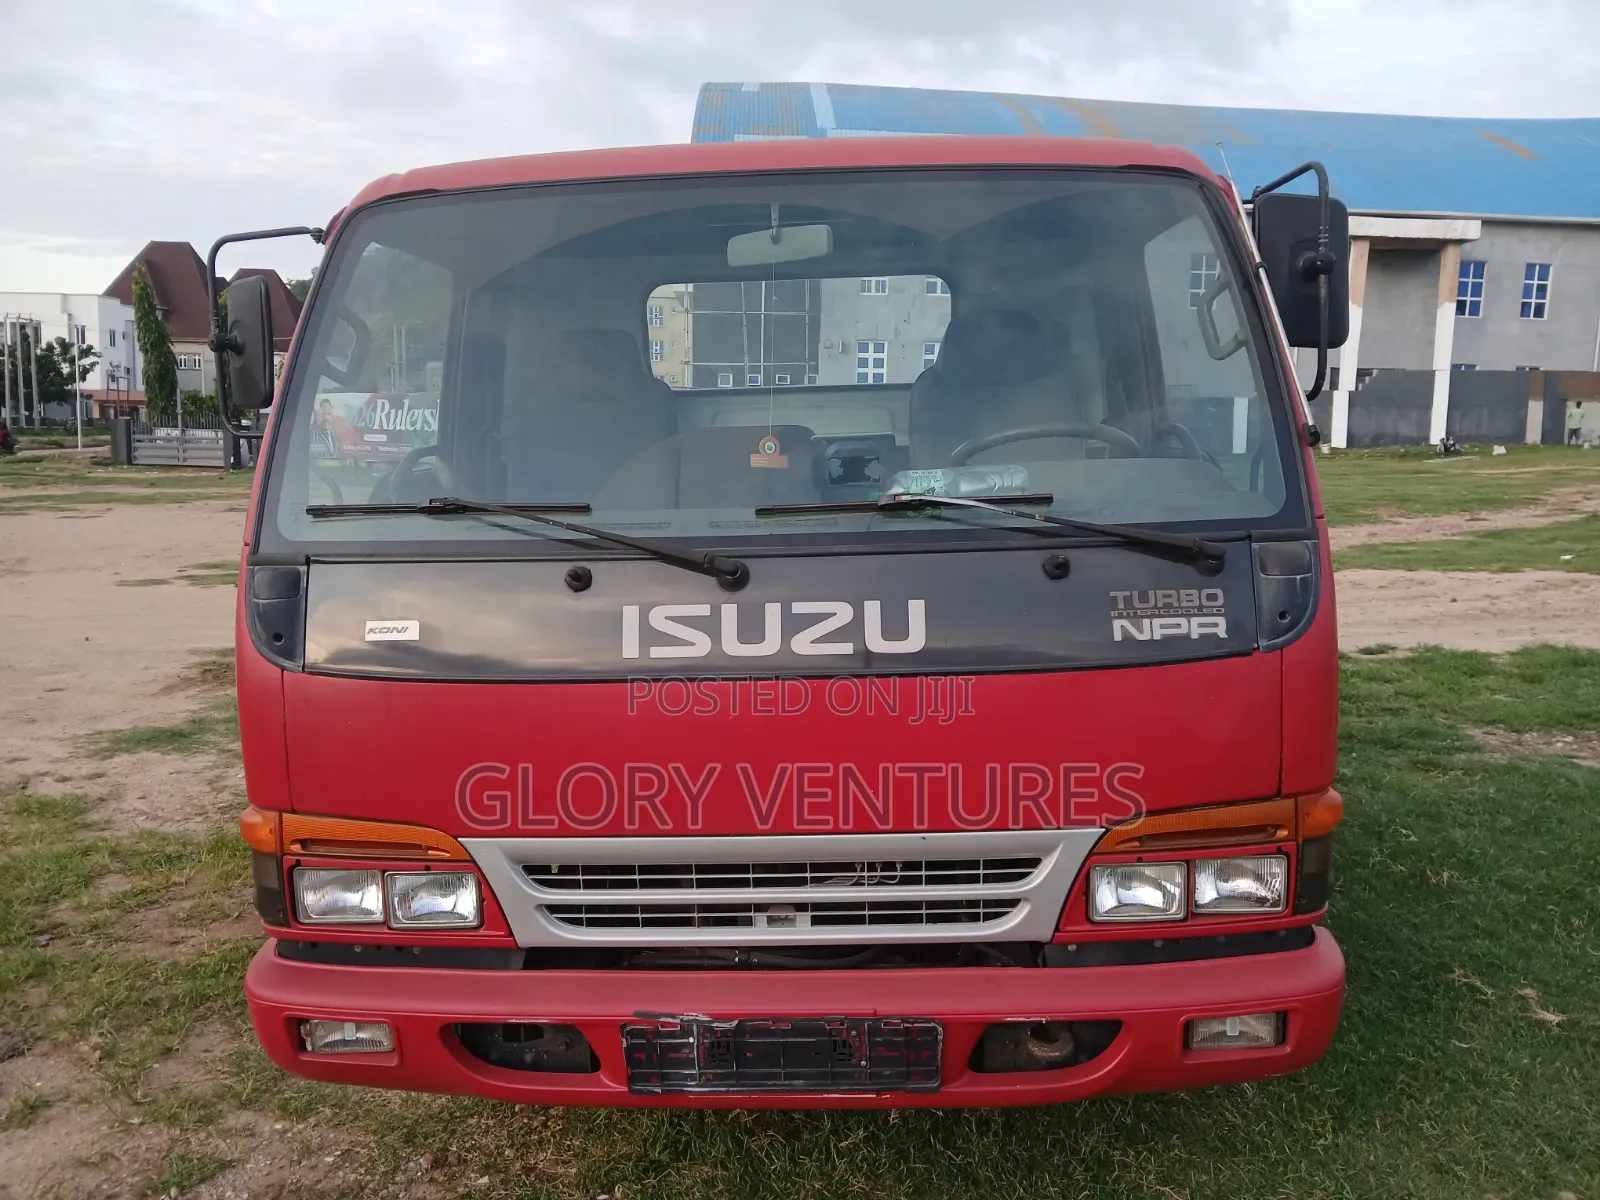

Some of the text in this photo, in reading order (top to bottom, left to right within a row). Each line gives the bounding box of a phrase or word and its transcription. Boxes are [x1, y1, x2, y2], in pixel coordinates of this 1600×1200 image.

[1109, 588, 1225, 608] TURBO
[1110, 608, 1225, 617] INTERCOOLED
[366, 626, 410, 635] KONI
[621, 599, 927, 659] ISUZU
[1112, 616, 1229, 642] NPR
